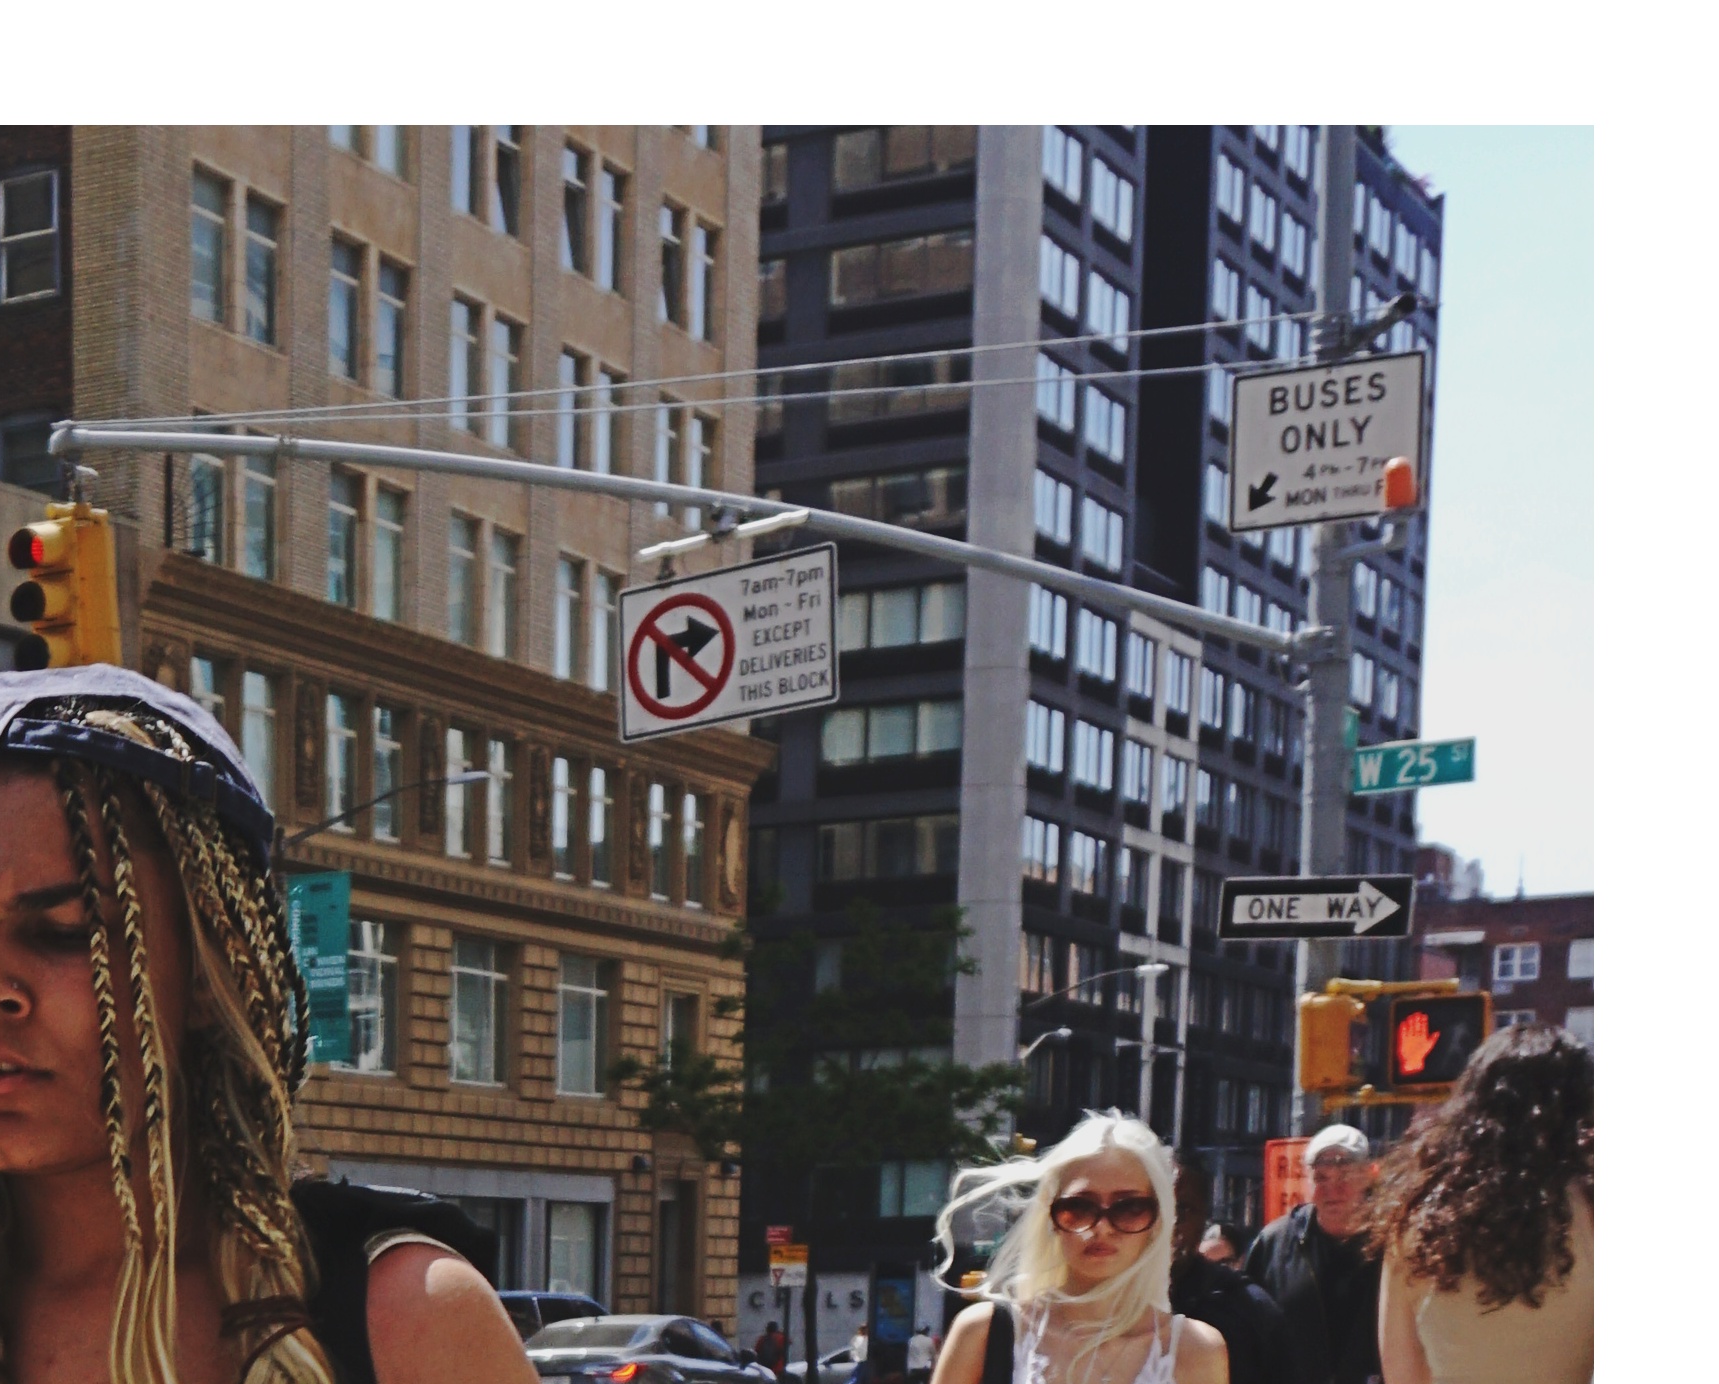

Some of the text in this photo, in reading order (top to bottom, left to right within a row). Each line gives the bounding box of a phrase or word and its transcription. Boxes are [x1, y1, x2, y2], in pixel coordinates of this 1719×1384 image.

[1269, 372, 1387, 415] BUSES
[1281, 415, 1373, 454] ONLY
[1285, 487, 1327, 507] MON
[740, 565, 824, 596] 7am-7pm
[742, 603, 779, 623] Mon
[797, 592, 822, 611] Fri
[753, 618, 812, 647] EXCEPT
[740, 643, 827, 677] DELIVERIES
[739, 669, 829, 702] THIS BLOCK
[1359, 752, 1383, 788] W
[1396, 746, 1438, 784] 25
[1248, 896, 1382, 920] ONE WAY
